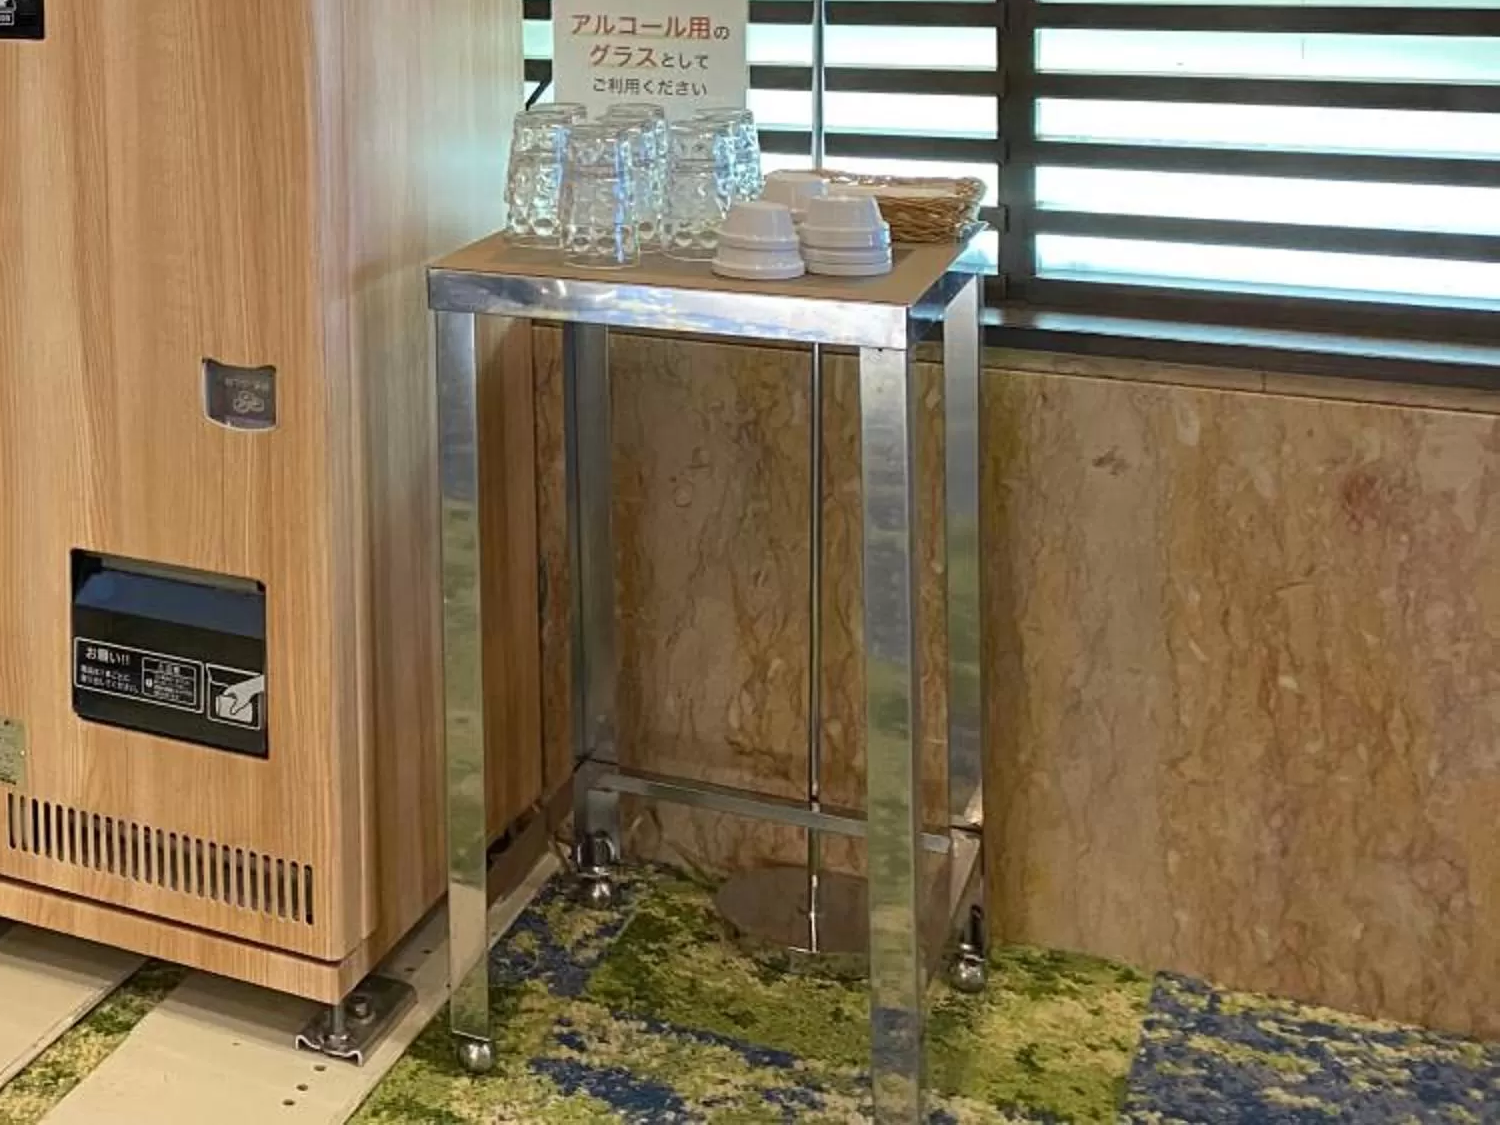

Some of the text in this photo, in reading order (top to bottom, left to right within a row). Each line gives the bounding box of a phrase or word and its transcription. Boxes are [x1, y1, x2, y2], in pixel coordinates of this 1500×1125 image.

[571, 13, 731, 40] アルコール用の
[589, 43, 709, 70] グラスとして
[592, 76, 708, 96] ご利用ください
